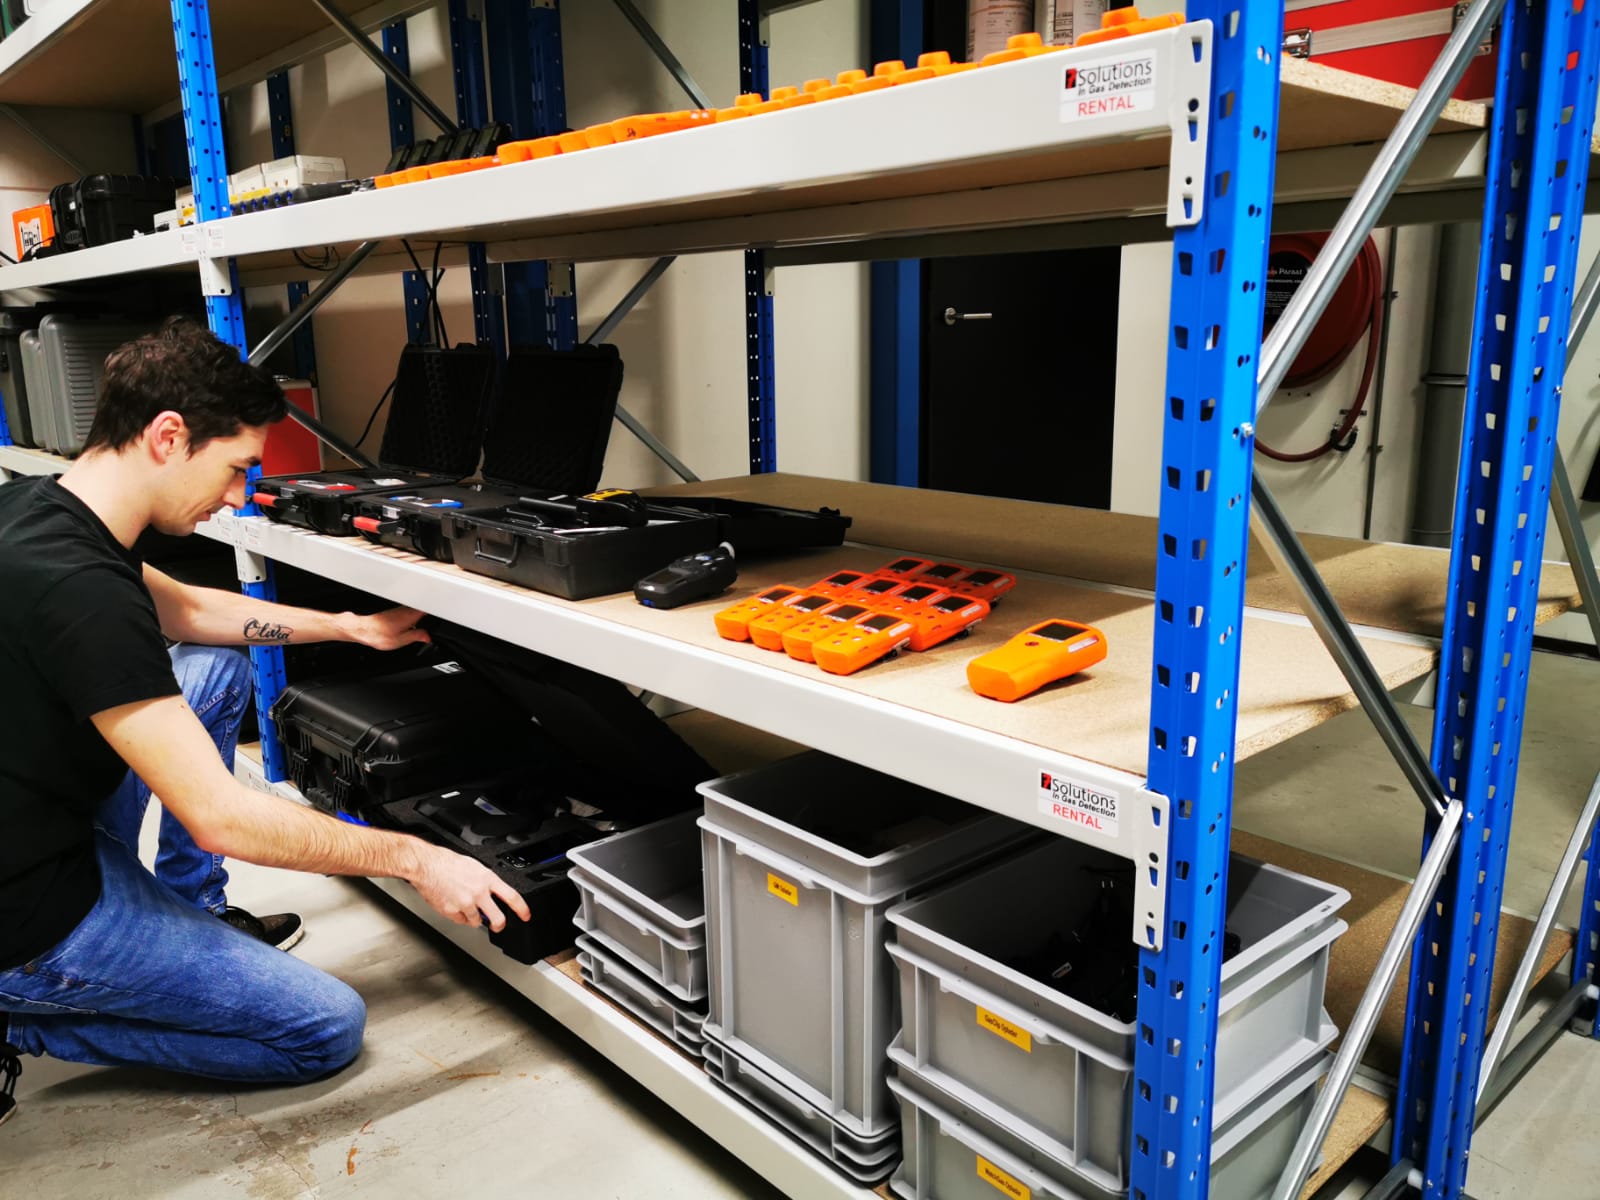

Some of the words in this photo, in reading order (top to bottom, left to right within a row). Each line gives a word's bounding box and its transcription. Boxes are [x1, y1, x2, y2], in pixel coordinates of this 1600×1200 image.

[1089, 84, 1105, 95] Gas
[1108, 76, 1152, 92] Detection
[1078, 94, 1135, 117] RENTAL
[1052, 803, 1103, 830] RENTAL
[1061, 794, 1076, 806] Gas
[1078, 799, 1116, 819] Detection
